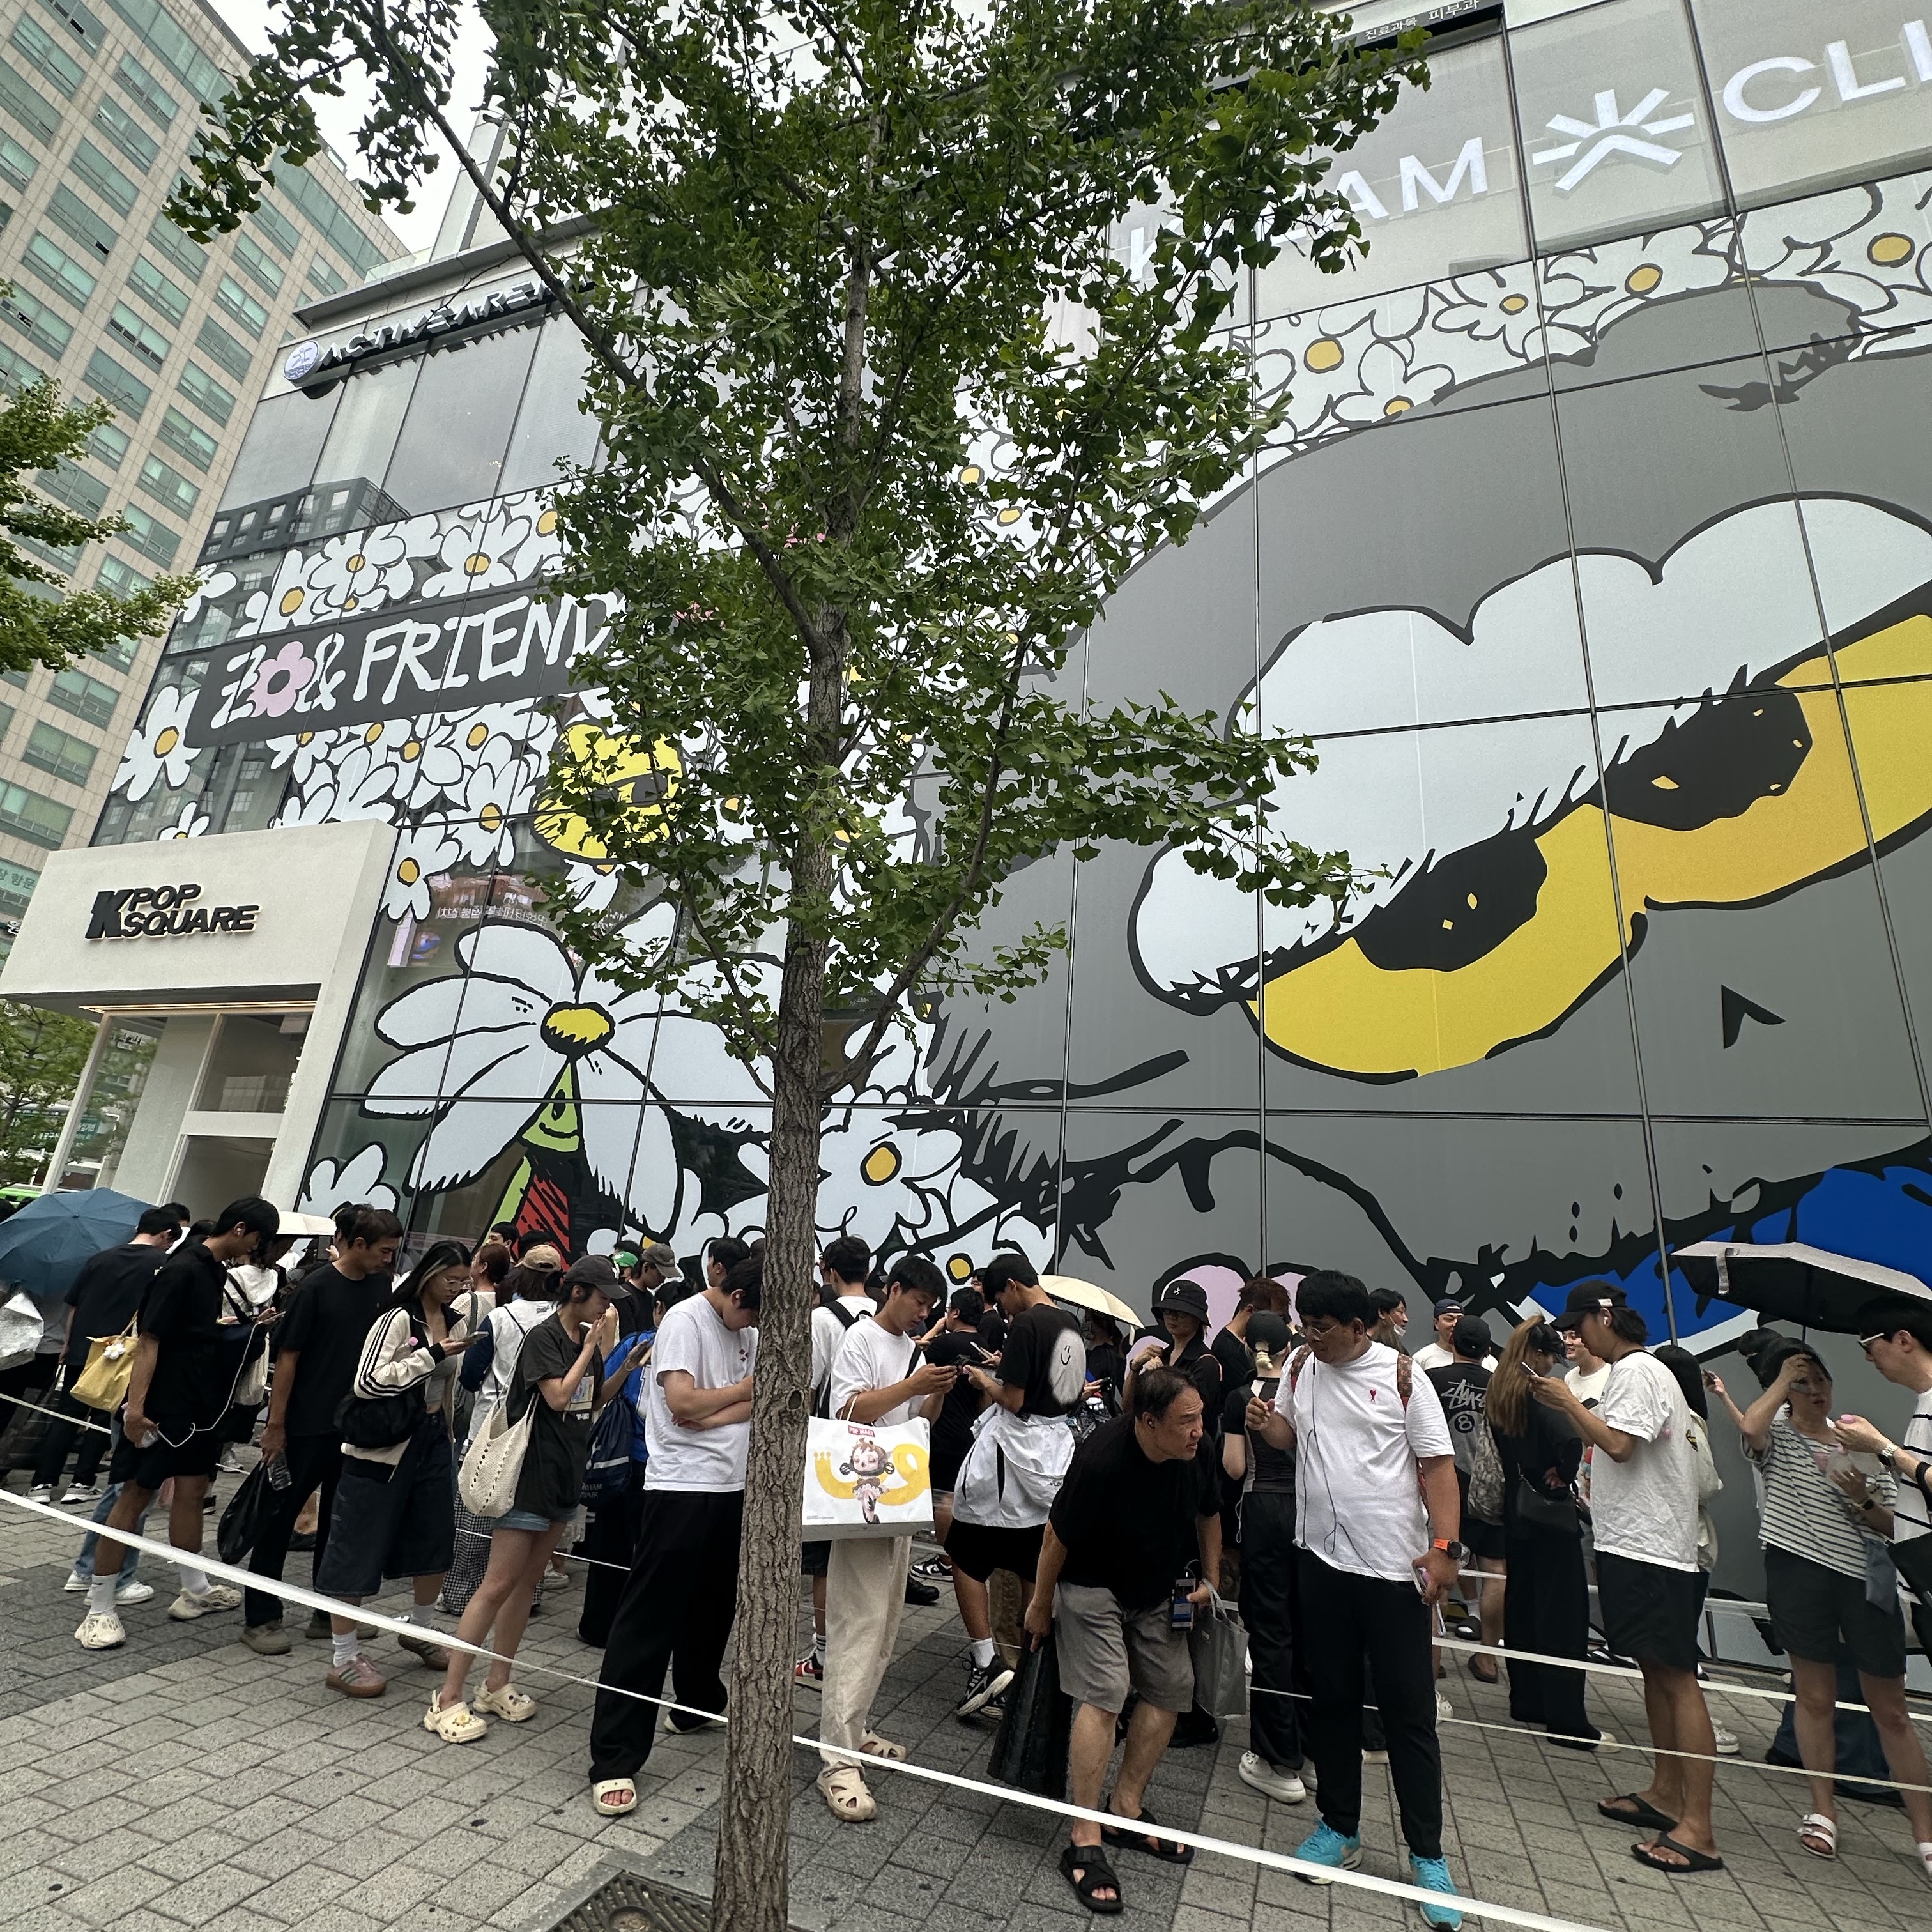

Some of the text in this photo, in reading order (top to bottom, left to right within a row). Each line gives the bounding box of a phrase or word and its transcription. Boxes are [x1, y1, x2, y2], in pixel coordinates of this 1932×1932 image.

[1365, 0, 1480, 40] 진료과목 피부과
[85, 884, 201, 938] KPOP
[121, 905, 260, 937] SQUARE
[849, 1426, 859, 1434] POP
[1458, 1415, 1473, 1430] 8
